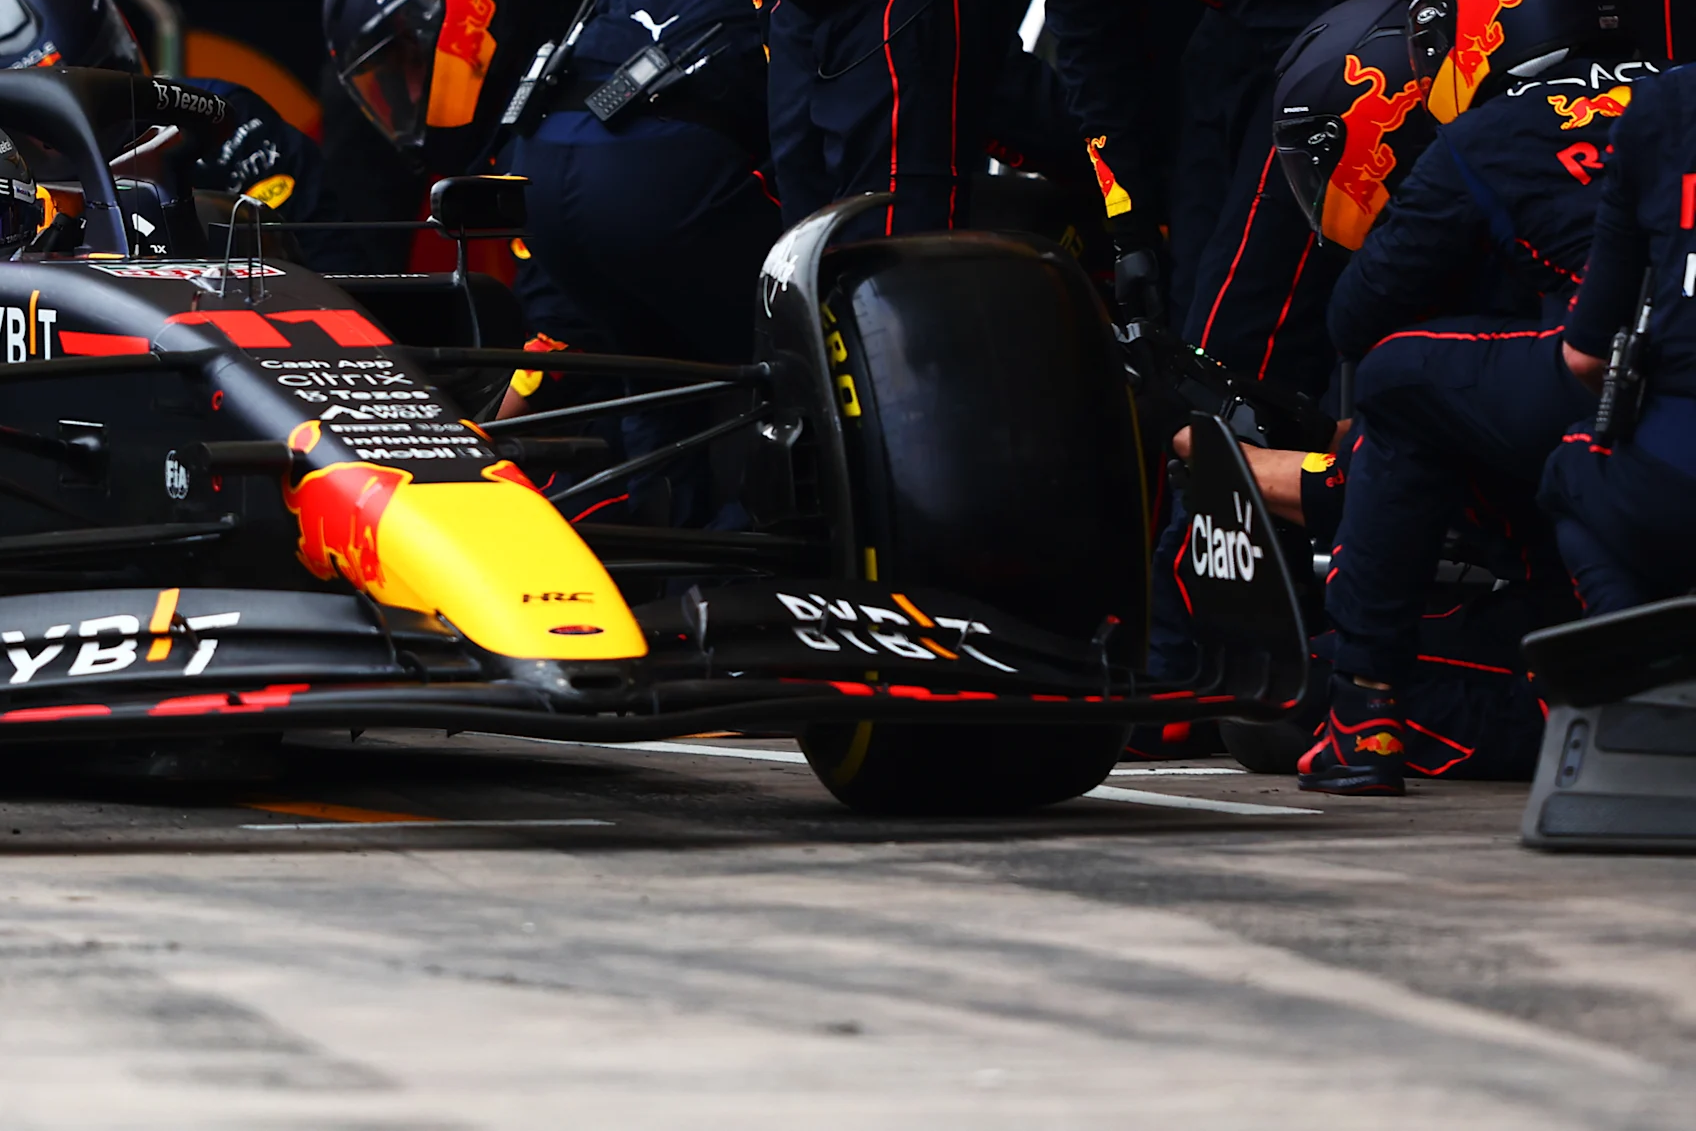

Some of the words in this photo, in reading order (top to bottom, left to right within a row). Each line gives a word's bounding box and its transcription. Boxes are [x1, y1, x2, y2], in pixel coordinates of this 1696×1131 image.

[164, 309, 394, 348] 11
[260, 359, 331, 369] Cash
[338, 359, 394, 370] App
[330, 390, 430, 400] Tezos
[359, 404, 442, 413] ARCTIC
[372, 410, 441, 419] WOLF
[356, 447, 456, 459] Mobil
[1192, 505, 1259, 582] Claro
[523, 591, 594, 604] HRC
